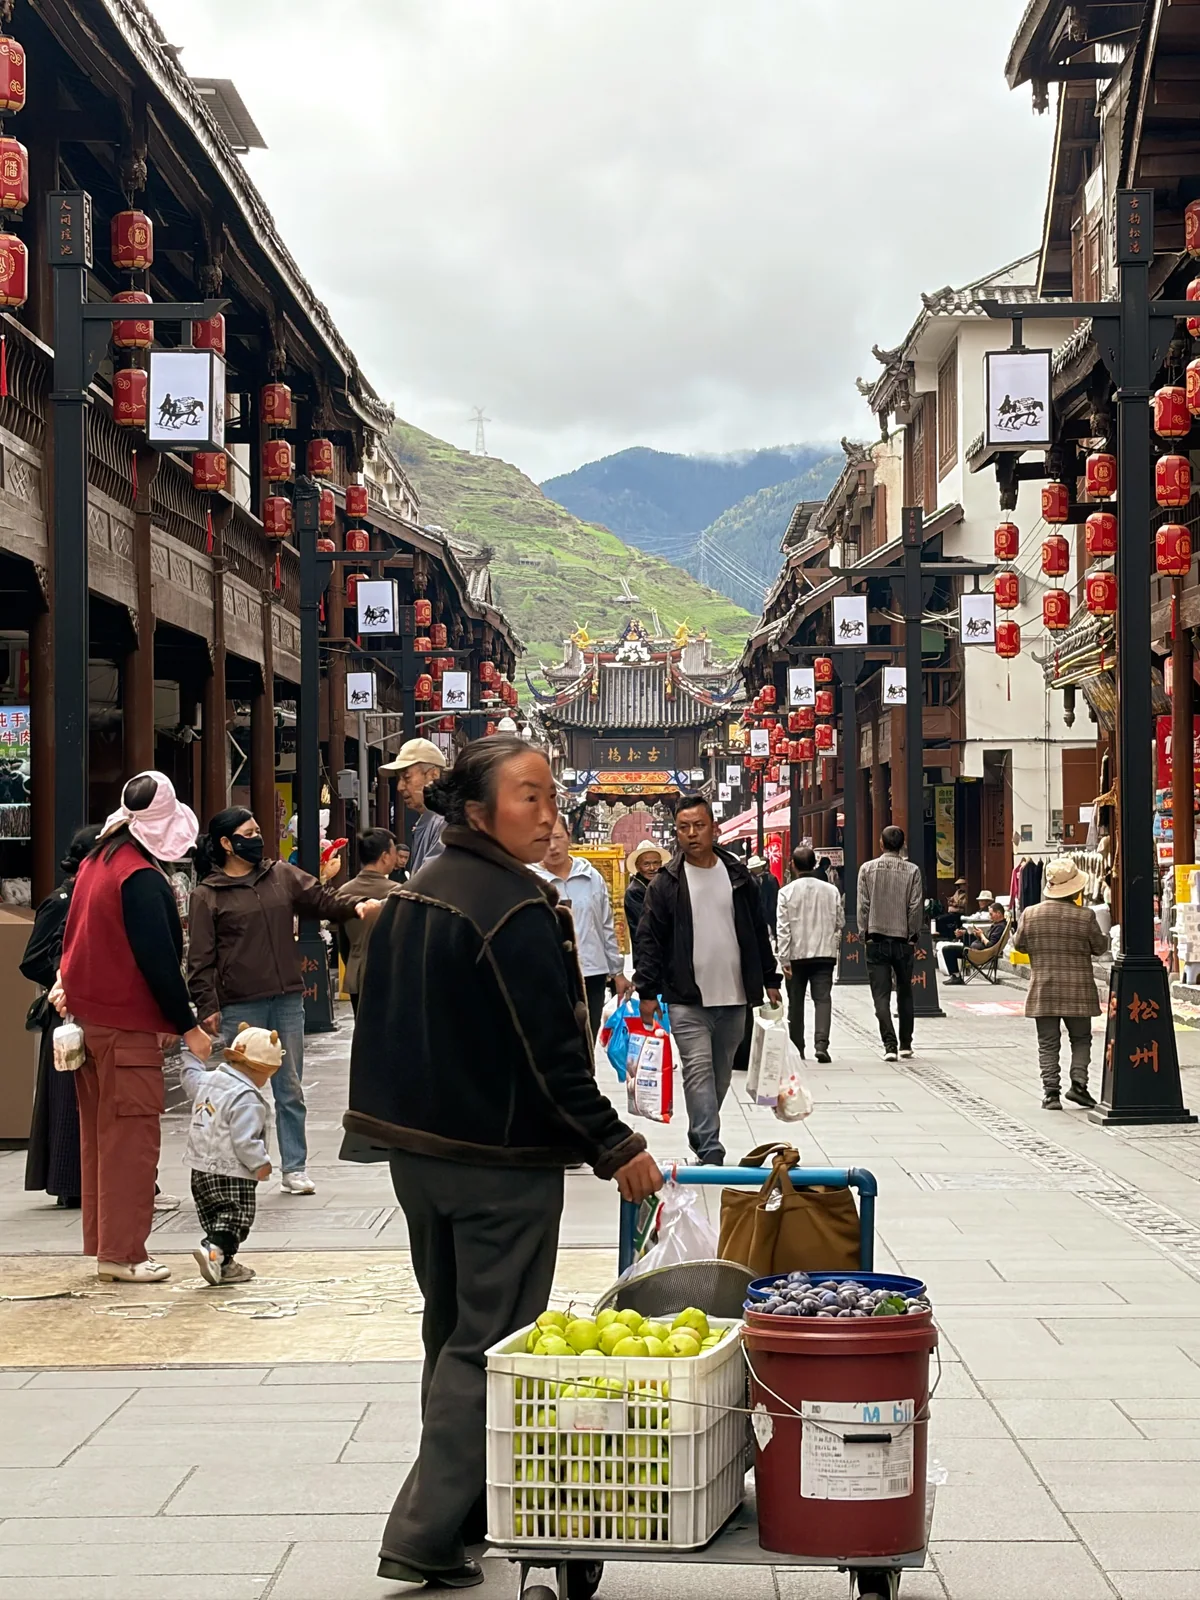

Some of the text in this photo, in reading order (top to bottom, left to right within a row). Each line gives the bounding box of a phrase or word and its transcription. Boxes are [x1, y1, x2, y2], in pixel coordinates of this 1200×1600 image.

[60, 200, 73, 256] 人间瑶池
[0, 711, 30, 728] 纯手
[1127, 992, 1160, 1073] 松州
[863, 1403, 911, 1423] Mbil
